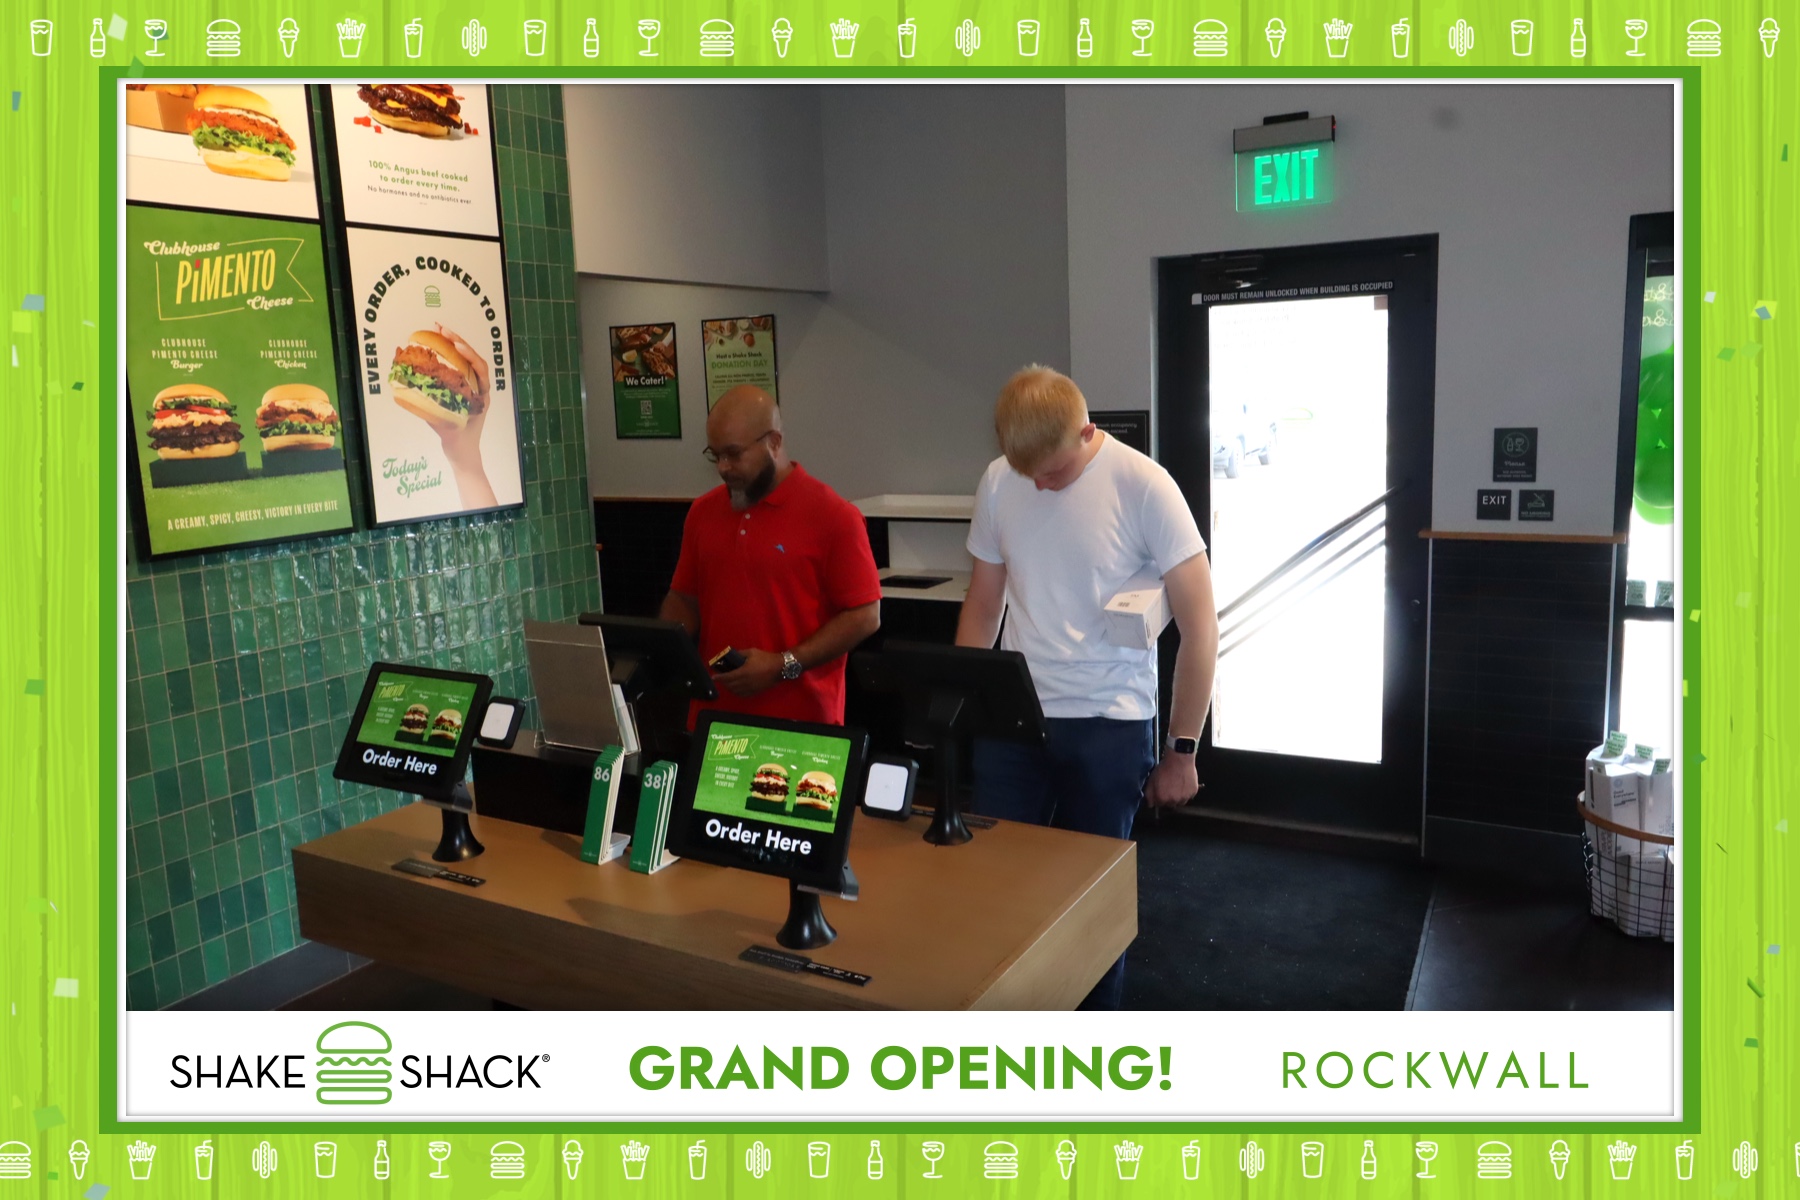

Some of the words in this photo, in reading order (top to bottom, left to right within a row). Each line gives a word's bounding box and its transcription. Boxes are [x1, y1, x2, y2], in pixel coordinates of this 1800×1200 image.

[369, 160, 391, 170] 100%
[394, 164, 419, 176] Angus
[421, 168, 439, 178] beef
[441, 172, 468, 182] cooked
[1254, 148, 1319, 205] EXIT
[380, 174, 388, 182] to
[391, 176, 414, 186] order
[416, 181, 438, 190] every
[441, 182, 460, 192] time.
[378, 186, 408, 196] hormones
[430, 194, 458, 203] antibiotics
[144, 240, 220, 256] Clubhouse
[415, 256, 481, 296] COOKED
[364, 263, 411, 323] ORDER,
[1203, 294, 1220, 302] DOOR
[1222, 292, 1238, 300] MUST
[1240, 291, 1264, 300] REMAIN
[1265, 289, 1298, 298] UNLOCKED
[1300, 287, 1318, 295] WHEN
[1320, 285, 1350, 294] BUILDING
[1352, 284, 1358, 292] IS
[1360, 281, 1394, 291] OCCUPIED
[246, 296, 294, 310] Cheese
[480, 295, 496, 321] TO
[162, 338, 206, 348] CLUBHOUSE
[268, 339, 308, 348] CLUBHOUSE
[152, 350, 187, 359] PIMENTO
[190, 350, 218, 359] CHEESE
[260, 350, 291, 359] PIMENTO
[294, 350, 318, 359] CHEESE
[363, 327, 381, 395] EVERY
[490, 326, 506, 391] ORDER
[170, 360, 203, 372] Burger
[274, 359, 307, 370] Chicken
[711, 360, 752, 369] DONATION
[753, 360, 768, 368] DAY
[626, 377, 638, 386] We
[382, 456, 428, 480] Today's
[396, 471, 442, 498] Special
[1482, 496, 1506, 505] EXIT
[168, 519, 174, 531] A
[174, 516, 208, 530] CREAMY,
[209, 512, 234, 526] SPICY,
[235, 508, 264, 523] CHEESY,
[264, 505, 293, 518] VICTORY
[294, 504, 302, 516] IN
[302, 502, 324, 514] EVERY
[324, 500, 338, 512] BITE
[362, 748, 402, 768] Order
[404, 756, 437, 775] Here
[594, 767, 610, 782] 86
[644, 773, 661, 790] 38
[706, 818, 761, 845] Order
[764, 829, 812, 854] Here
